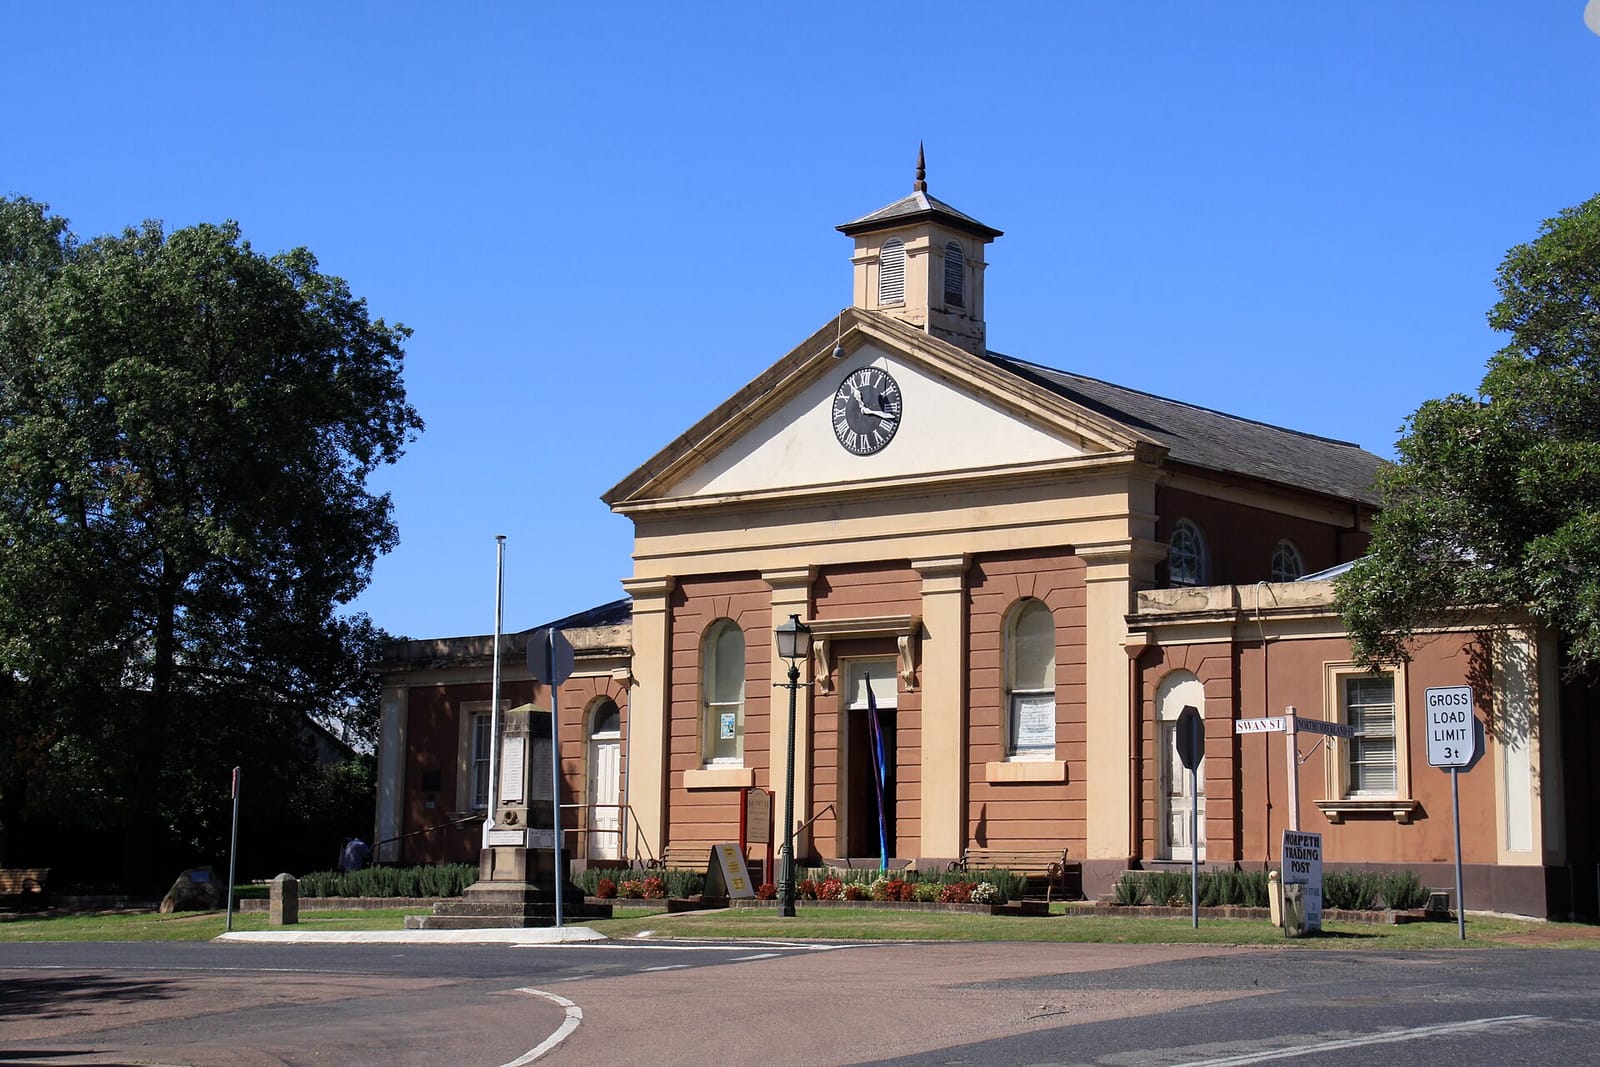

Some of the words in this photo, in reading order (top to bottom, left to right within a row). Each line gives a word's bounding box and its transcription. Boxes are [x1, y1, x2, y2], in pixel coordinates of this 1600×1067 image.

[1429, 693, 1468, 707] GROSS
[1433, 711, 1466, 724] LOAD
[1237, 720, 1267, 732] SWAN
[1269, 719, 1280, 729] ST
[1434, 728, 1466, 741] LIMIT
[1284, 834, 1320, 848] MORPETH
[1285, 847, 1319, 861] TRADING
[1291, 860, 1310, 873] POST
